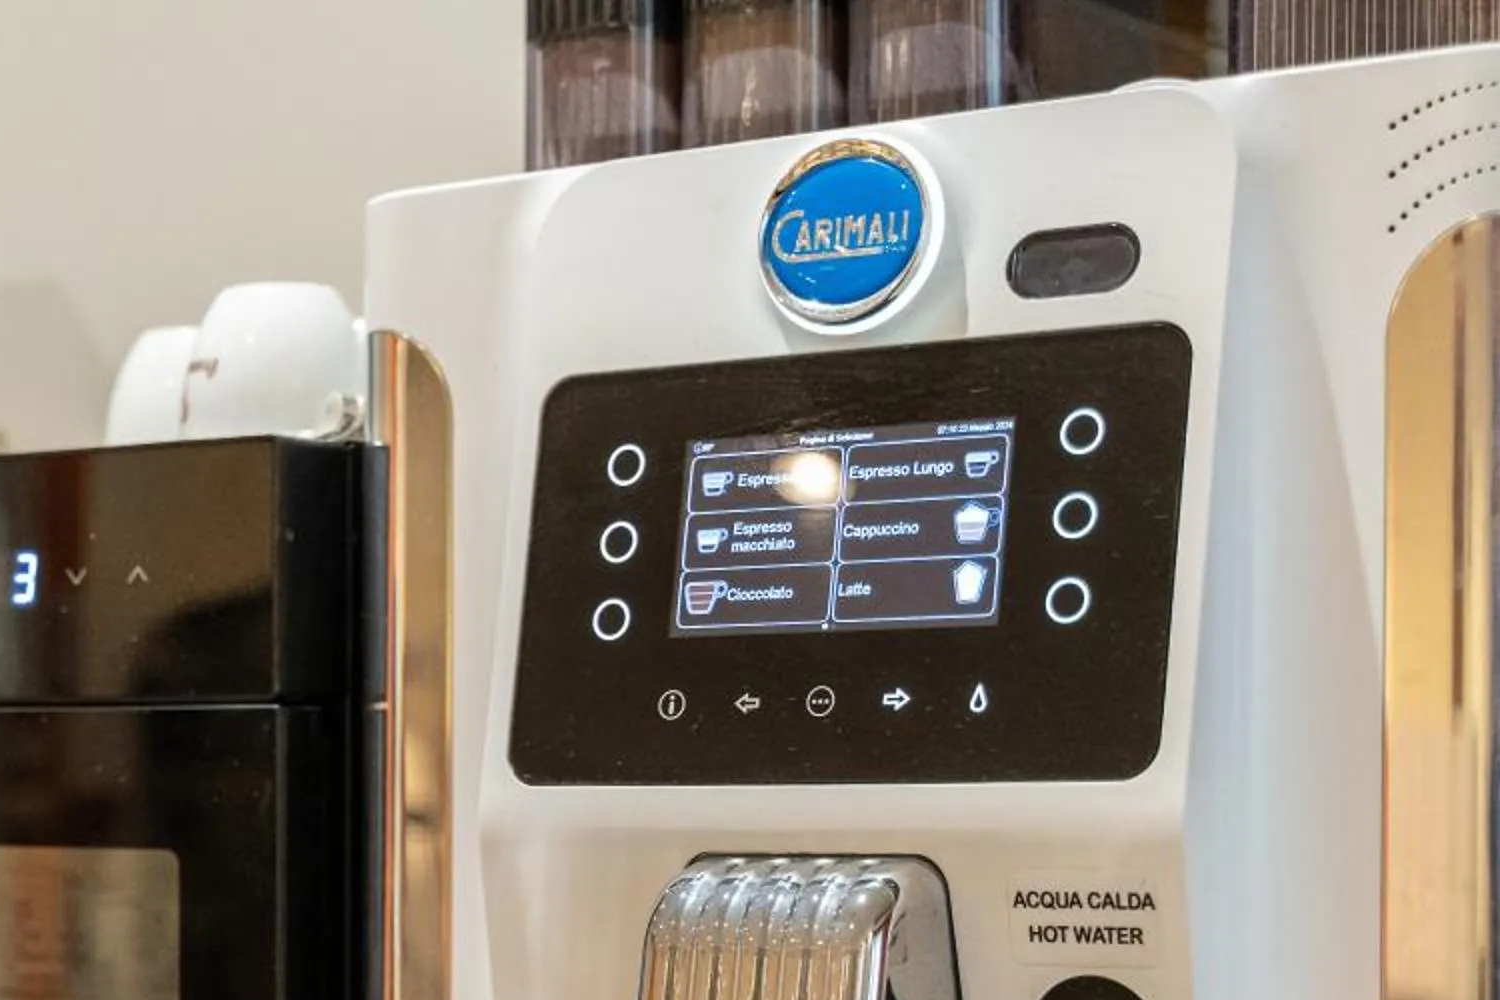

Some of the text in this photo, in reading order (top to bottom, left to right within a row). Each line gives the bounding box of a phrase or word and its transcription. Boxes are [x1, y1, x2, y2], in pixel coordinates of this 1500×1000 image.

[771, 209, 911, 264] CARIMALI
[849, 460, 955, 481] Espresso Lungo
[733, 521, 793, 537] Espresso
[842, 521, 920, 540] Cappuccino
[730, 537, 796, 553] macchiato
[12, 552, 39, 605] 3
[726, 585, 794, 601] Cioccolato
[837, 581, 872, 597] Latte
[1012, 890, 1157, 911] ACQUA CALDA
[1028, 925, 1145, 946] HOT WATER
